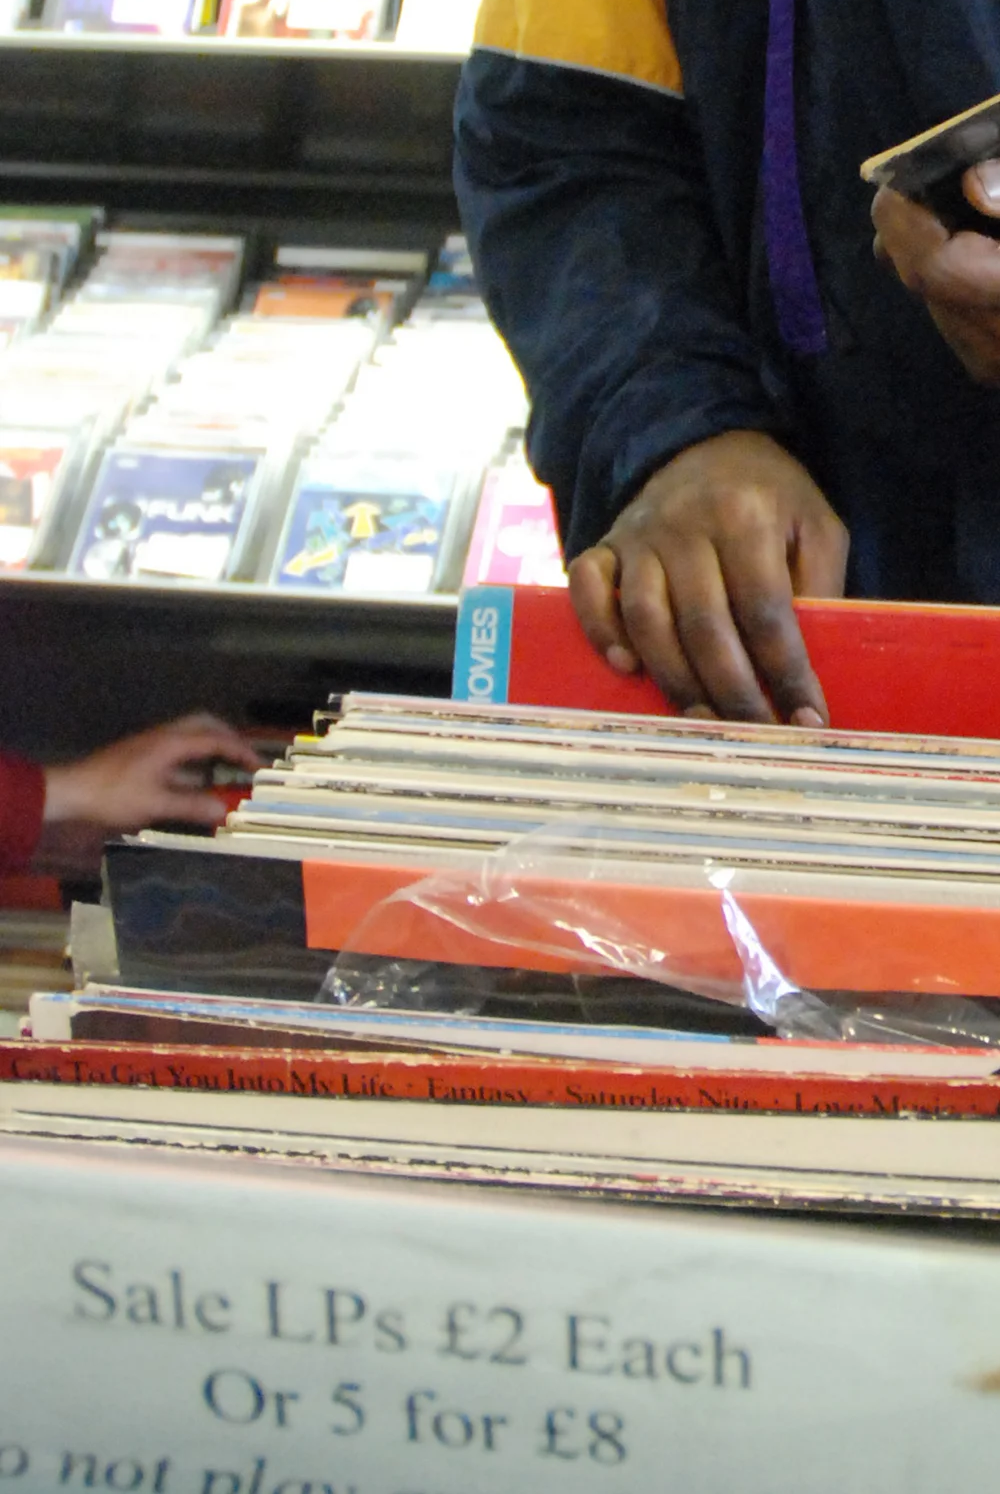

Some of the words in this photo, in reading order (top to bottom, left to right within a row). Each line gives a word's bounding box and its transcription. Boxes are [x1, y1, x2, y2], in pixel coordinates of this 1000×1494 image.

[342, 1073, 394, 1098] Life
[71, 1258, 231, 1334] Sale
[264, 1280, 405, 1353] LPs
[438, 1302, 527, 1367] £2
[565, 1313, 753, 1389] Each
[203, 1367, 298, 1428] Or
[331, 1381, 366, 1436] 5
[406, 1389, 508, 1452] for
[538, 1406, 628, 1466] £8
[0, 1443, 30, 1478] o
[60, 1450, 171, 1494] not
